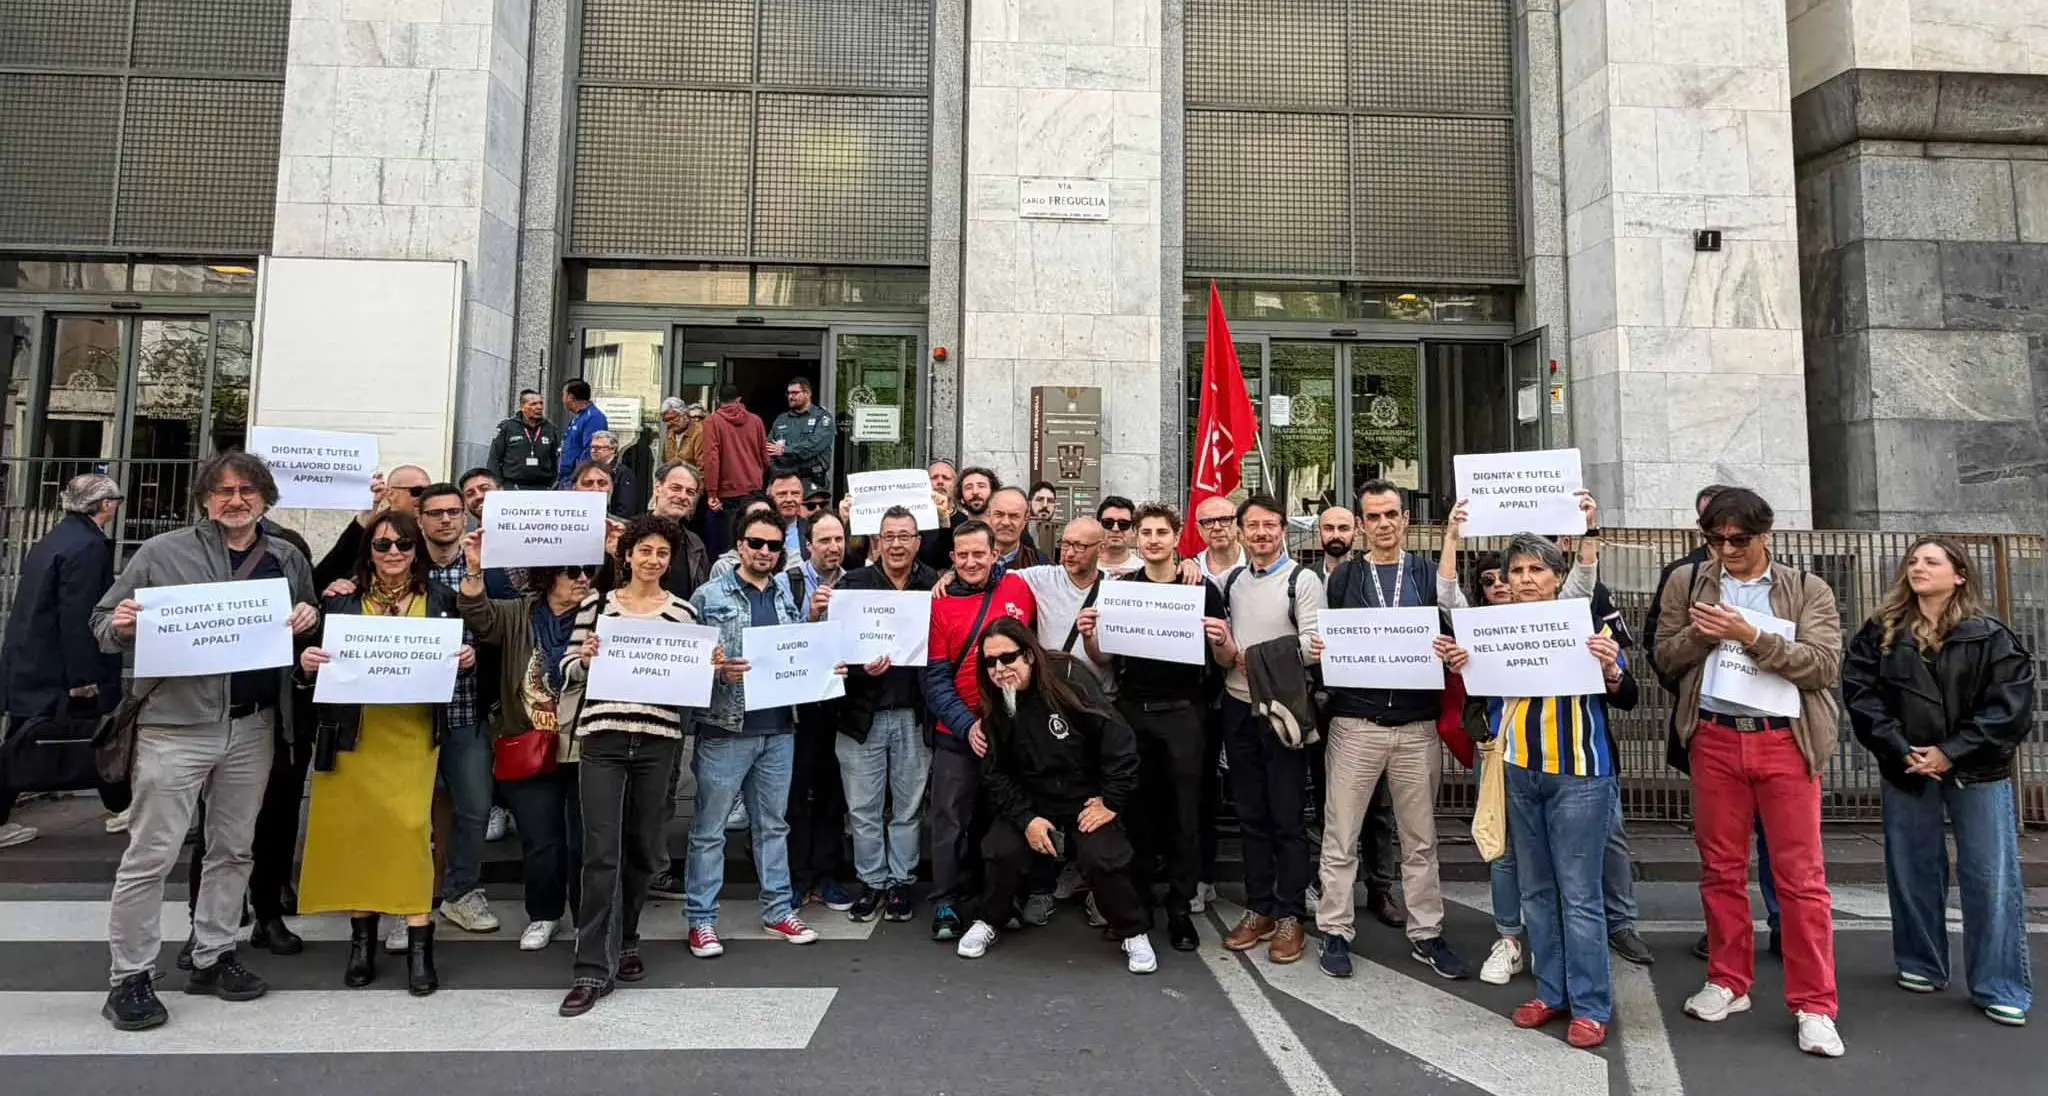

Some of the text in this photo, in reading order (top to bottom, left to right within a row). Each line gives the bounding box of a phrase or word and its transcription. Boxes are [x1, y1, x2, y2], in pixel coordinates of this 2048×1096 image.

[1048, 196, 1106, 207] FREGUGLIA
[1707, 232, 1713, 247] 1
[271, 446, 360, 457] DIGNITA' E TUTELE
[267, 460, 362, 471] NEL LAVORO DEGLI
[293, 474, 334, 485] APPALTI
[1473, 470, 1561, 480] DIGNITA' E TUTELE
[854, 484, 887, 494] DECRETO
[1471, 484, 1565, 495] NEL LAVORO DEGLI
[1499, 500, 1538, 509] APPALTI
[501, 508, 588, 517] DIGNITA' E TUTELE
[498, 522, 590, 532] NEL LAVORO DEGLI
[160, 598, 269, 616] DIGNITA' E TUTELE
[1104, 598, 1143, 608] DECRETO
[1154, 601, 1196, 611] MAGGIO?
[863, 607, 896, 615] LAVORO
[158, 614, 273, 634] NEL LAVORO DEGLI
[875, 619, 880, 628] E
[1473, 621, 1570, 637] DIGNITA' E TUTELE
[1105, 624, 1146, 636] TUTELARE
[1156, 629, 1194, 639] LAVORO!
[1326, 626, 1371, 635] DECRETO
[1384, 625, 1430, 635] MAGGIO?
[192, 633, 240, 646] APPALTI
[344, 634, 441, 645] DIGNITA' E TUTELE
[611, 635, 699, 648] DIGNITA' E TUTELE
[859, 632, 896, 641] DIGNITA'
[776, 640, 809, 651] LAVORO
[1473, 638, 1576, 653] NEL LAVORO DEGLI
[339, 650, 442, 660] NEL LAVORO DEGLI
[608, 649, 699, 664] NEL LAVORO DEGLI
[789, 655, 795, 664] E
[1330, 654, 1432, 663] TUTELARE IL LAVORO!
[1506, 656, 1549, 667] APPALTI
[367, 666, 411, 676] APPALTI
[631, 666, 671, 677] APPALTI
[775, 668, 809, 680] DIGNITA'
